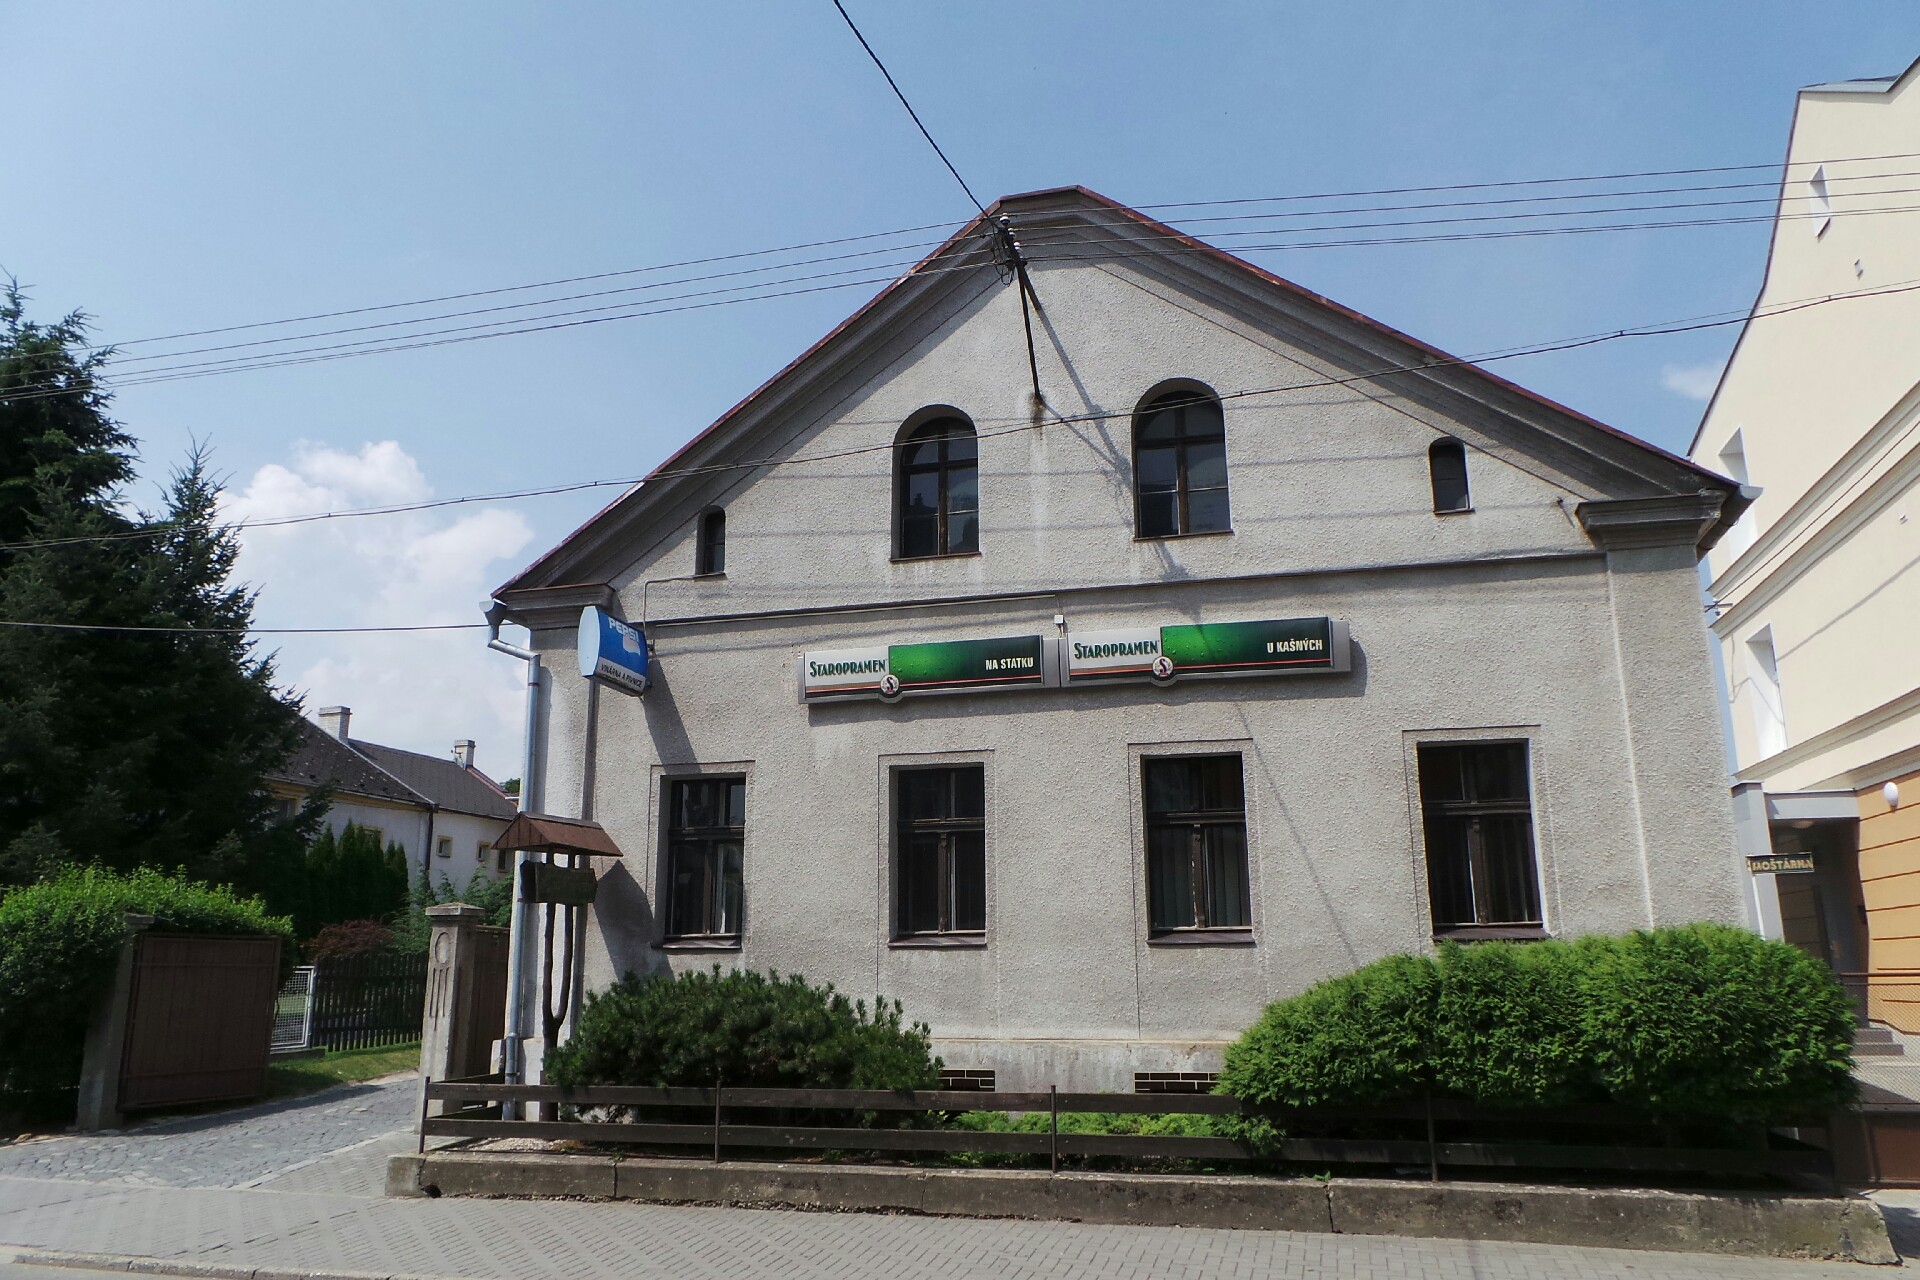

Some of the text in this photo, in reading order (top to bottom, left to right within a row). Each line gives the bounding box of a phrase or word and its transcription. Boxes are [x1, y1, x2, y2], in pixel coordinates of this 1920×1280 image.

[608, 617, 639, 642] PEPSI
[1073, 641, 1158, 659] STAROPRAMEN
[1267, 638, 1323, 653] U KAŠNÝCH
[809, 659, 886, 677] STAROPRAMEN
[985, 657, 1034, 670] NA STATKU
